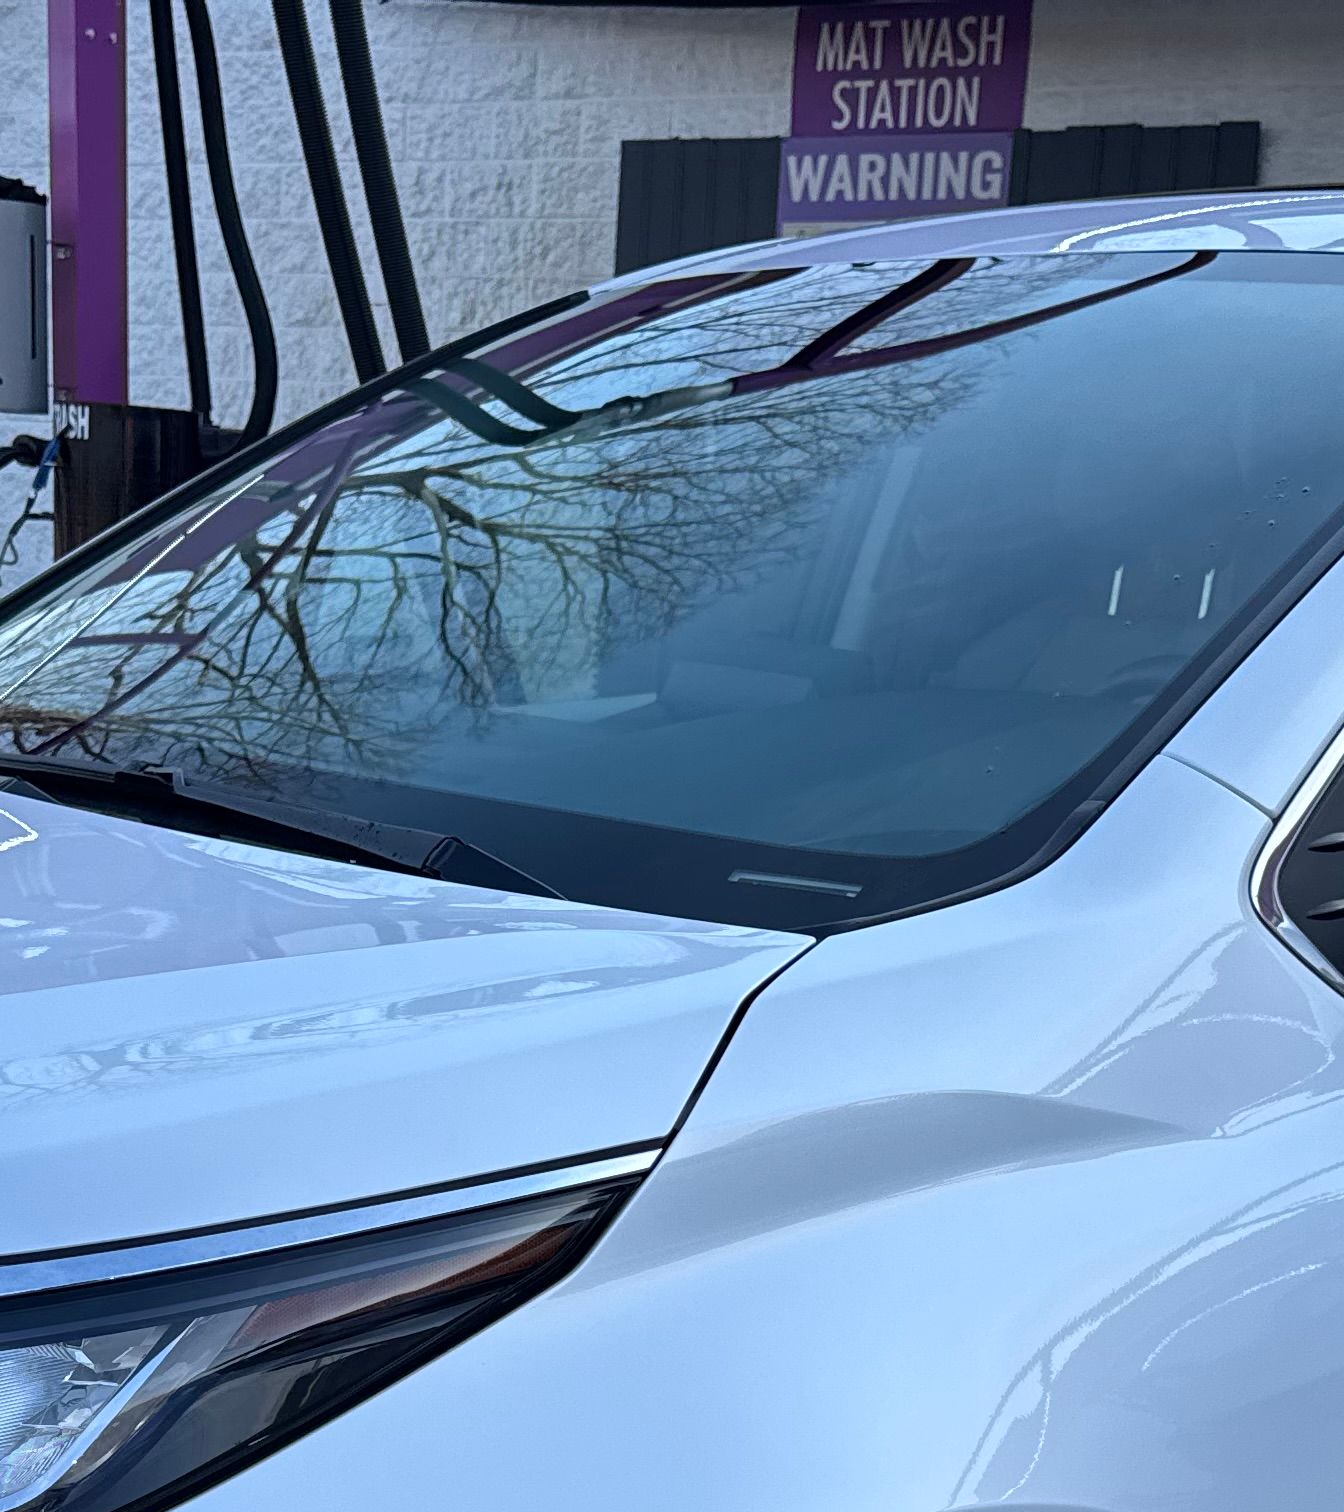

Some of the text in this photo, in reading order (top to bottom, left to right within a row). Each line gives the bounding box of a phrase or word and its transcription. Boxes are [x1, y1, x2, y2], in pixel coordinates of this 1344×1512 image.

[816, 15, 1005, 72] MAT WASH
[831, 76, 980, 130] STATION
[787, 151, 1004, 202] WARNING
